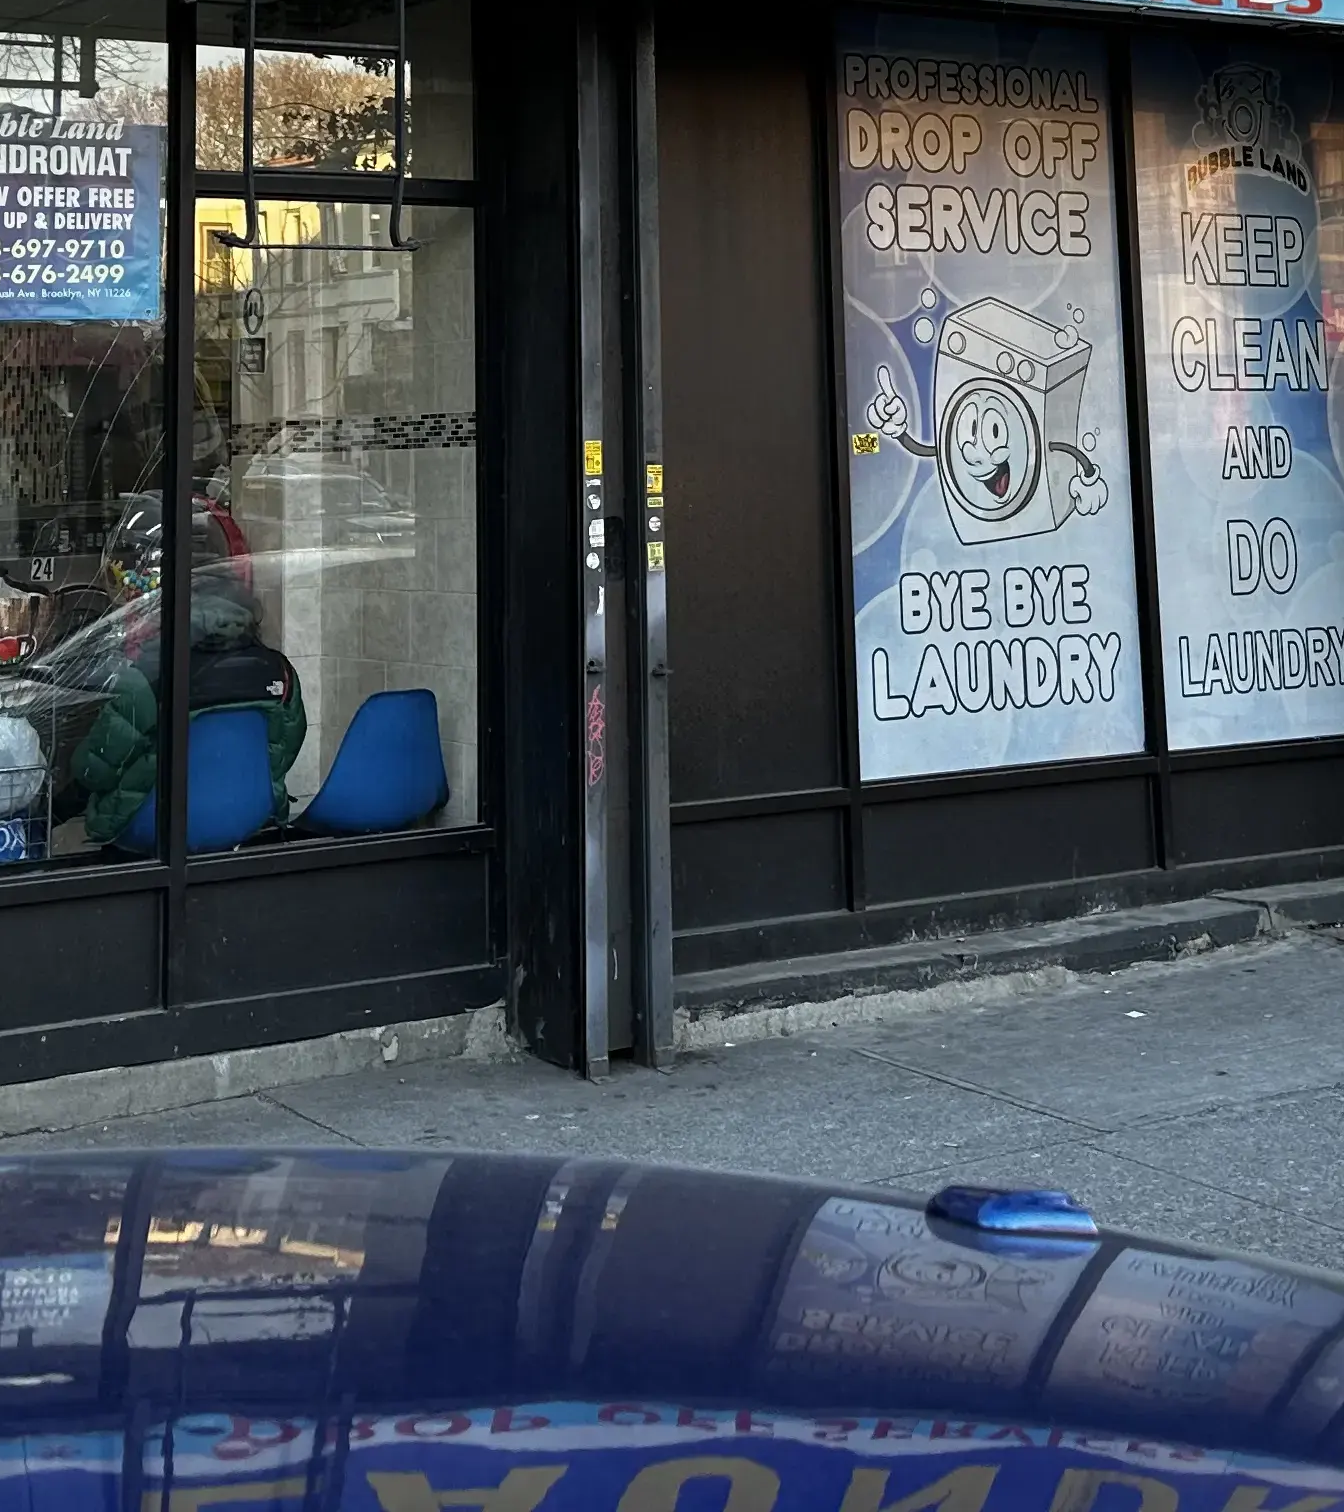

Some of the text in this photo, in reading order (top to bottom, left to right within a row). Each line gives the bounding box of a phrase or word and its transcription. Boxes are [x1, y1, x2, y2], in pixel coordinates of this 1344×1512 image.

[844, 55, 1099, 114] PROFESSIONAL
[50, 116, 126, 141] Land
[846, 109, 1101, 181] DROP OFF
[16, 186, 81, 208] OFFER
[87, 187, 135, 209] FREE
[1259, 148, 1307, 192] LAND
[3, 211, 28, 230] UP
[34, 214, 48, 230] &
[54, 212, 134, 231] DELIVERY
[865, 185, 1092, 257] SERVICE
[1181, 211, 1305, 289] KEEP
[87, 288, 101, 299] NY
[105, 288, 131, 299] 11226
[1170, 316, 1329, 393] CLEAN
[1221, 425, 1293, 481] AND
[31, 558, 55, 581] 24
[1226, 516, 1298, 595] DO
[898, 564, 1092, 635] BYE BYE
[871, 631, 1122, 722] LAUNDRY
